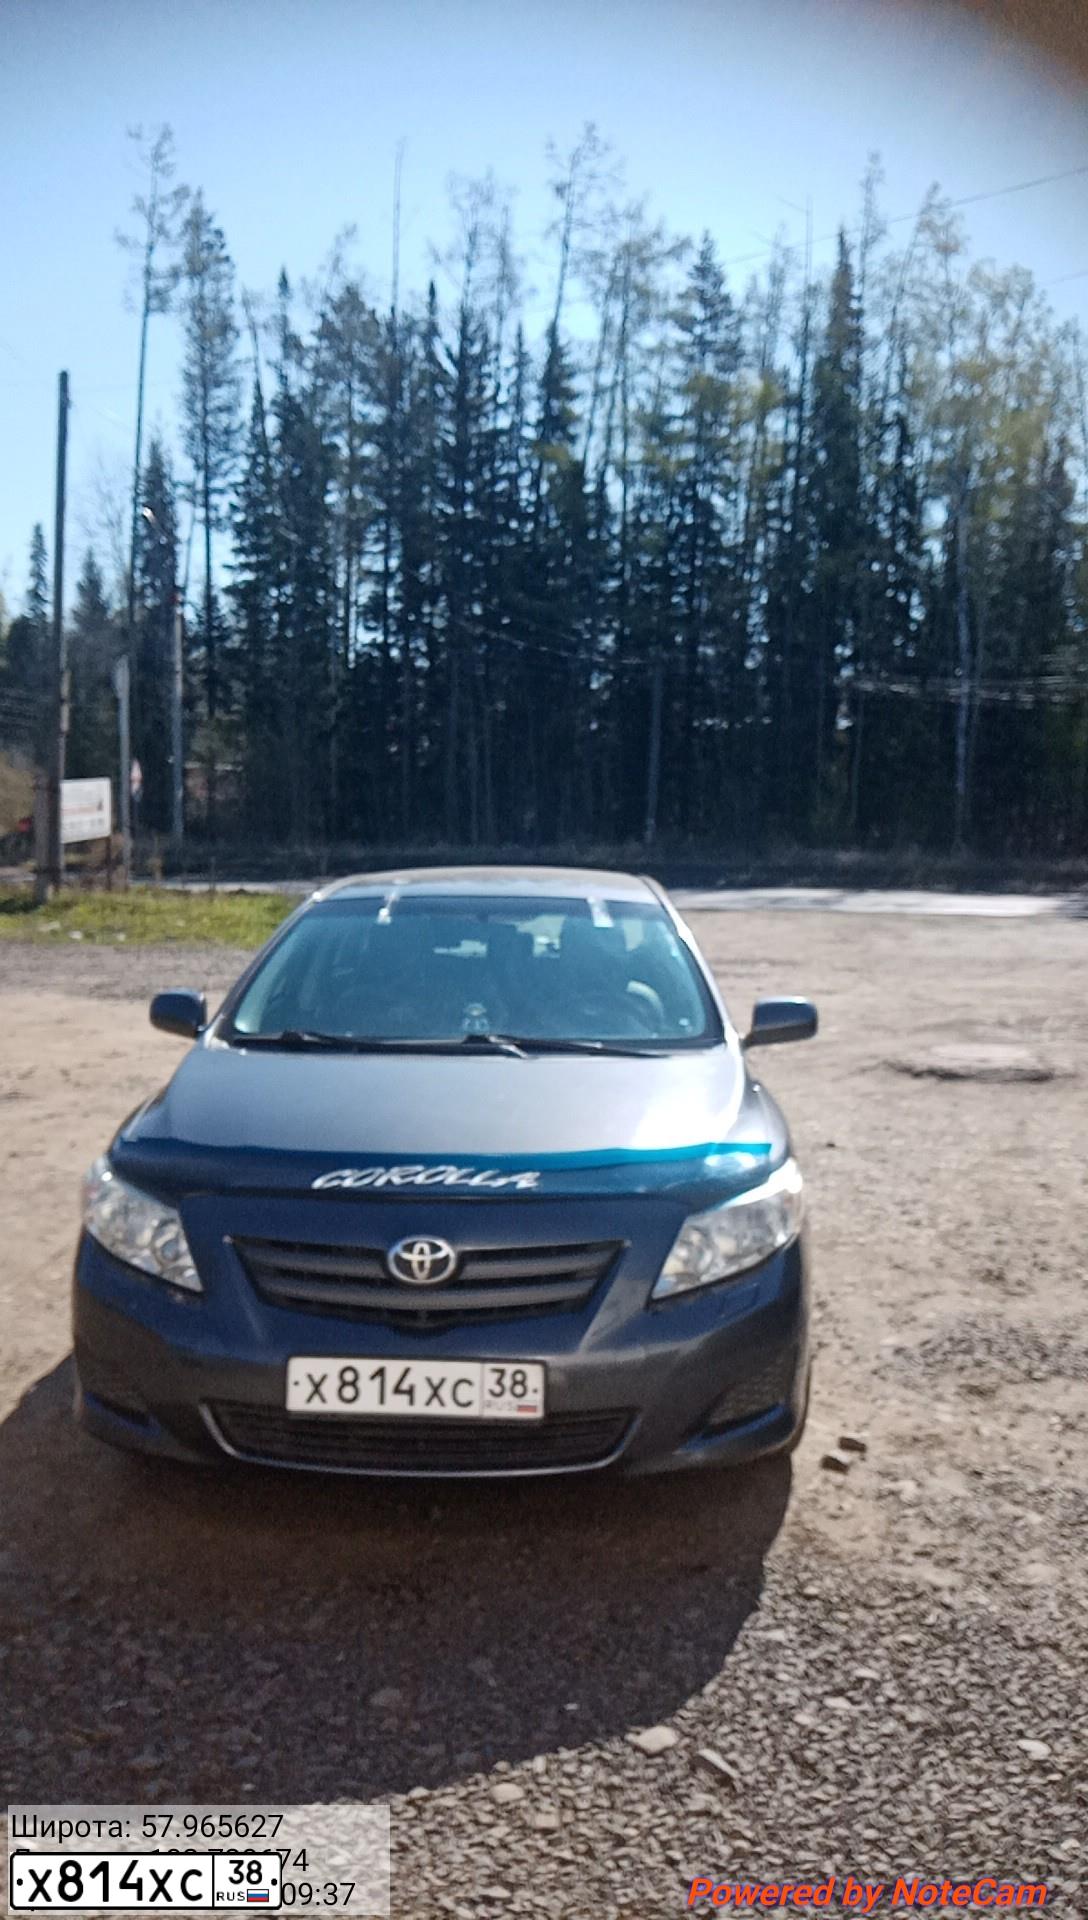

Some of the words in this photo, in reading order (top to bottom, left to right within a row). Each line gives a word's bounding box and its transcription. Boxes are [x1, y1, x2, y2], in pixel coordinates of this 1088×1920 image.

[311, 1165, 541, 1190] COROLLA
[305, 1366, 474, 1408] Х814ХС
[488, 1368, 528, 1399] 38
